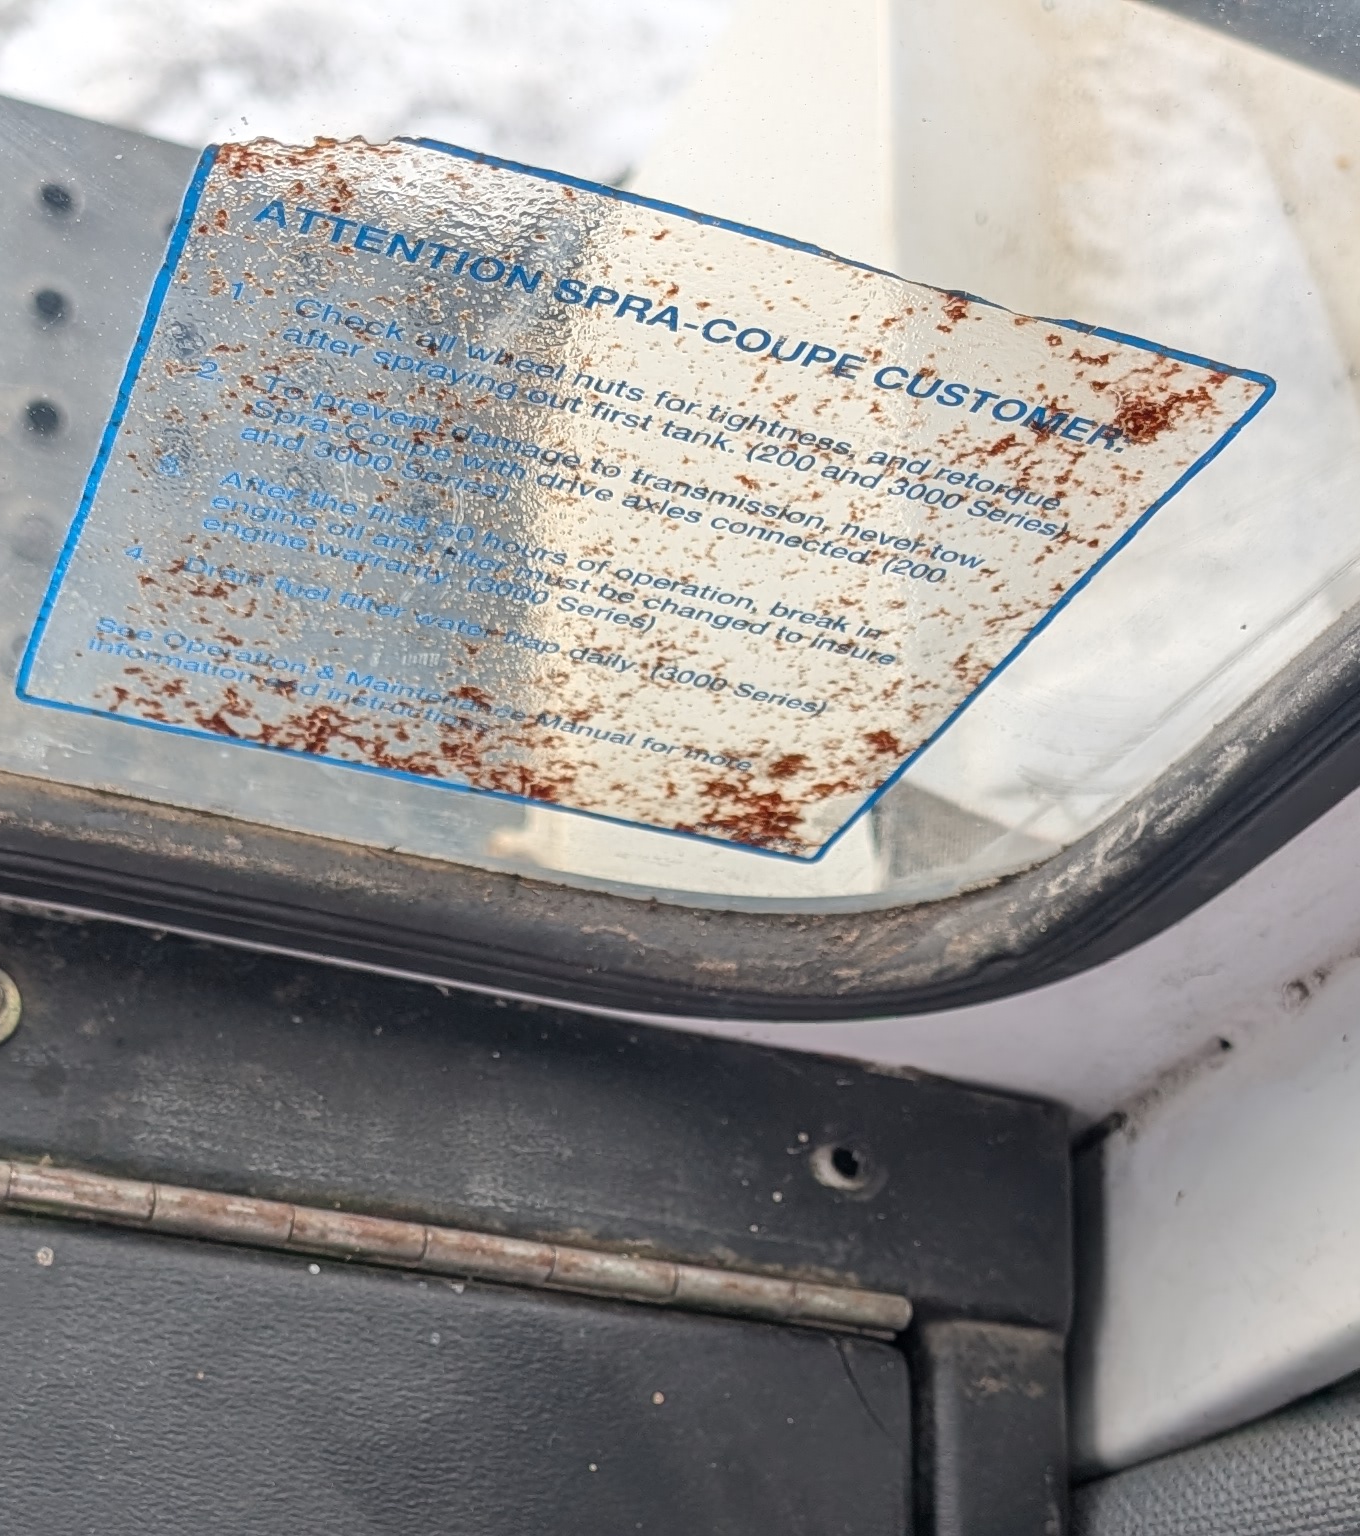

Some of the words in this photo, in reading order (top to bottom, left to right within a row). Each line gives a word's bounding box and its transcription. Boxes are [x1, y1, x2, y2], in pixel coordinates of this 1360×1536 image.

[252, 199, 545, 294] ATTENTION
[553, 278, 868, 380] SPRA-COUPE
[196, 360, 224, 382] 2.
[265, 374, 304, 400] To
[312, 392, 443, 435] prevent
[450, 424, 581, 470] damage
[590, 457, 622, 479] to
[629, 468, 829, 534] transmission,
[840, 522, 927, 553] never
[930, 544, 986, 571] tow
[231, 281, 255, 303] 1.
[295, 299, 405, 342] Check
[415, 332, 458, 354] all
[466, 343, 566, 382] wheel
[573, 371, 645, 403] nuts
[654, 390, 702, 415] for
[709, 404, 856, 461] tightness,
[868, 449, 932, 477] and
[933, 466, 1062, 512] retorque
[240, 425, 306, 452] and
[313, 440, 393, 474] 3000
[401, 460, 510, 501] Series)
[282, 327, 365, 359] after
[372, 350, 520, 402] spraying
[528, 387, 584, 414] out
[590, 400, 654, 432] first
[660, 418, 736, 453] tank.
[745, 441, 816, 473] (200
[820, 464, 883, 491] and
[887, 476, 964, 510] 3000
[966, 500, 1070, 542] Series)
[202, 516, 308, 550] engine
[468, 575, 549, 605] (3000
[556, 595, 657, 634] Series)
[218, 471, 302, 501] After
[309, 489, 358, 516] the
[367, 504, 430, 532] first
[481, 533, 568, 566] hours
[577, 557, 611, 575] of
[614, 568, 758, 615] operation,
[769, 601, 851, 633] break
[855, 620, 883, 640] in
[251, 400, 451, 462] Spra-Coupe
[462, 452, 527, 480] with
[536, 470, 614, 502] drive
[622, 495, 702, 525] axles
[881, 554, 947, 583] (200
[183, 556, 265, 588] Drain
[275, 575, 332, 600] fuel
[340, 590, 406, 619] filter
[569, 646, 639, 674] daily.
[650, 661, 728, 692] (3000
[733, 682, 828, 718] Series)
[211, 494, 319, 530] engine
[328, 522, 365, 541] oil
[372, 532, 432, 554] and
[514, 566, 592, 595] must
[598, 583, 636, 605] be
[642, 595, 771, 636] changed
[775, 625, 804, 644] to
[809, 631, 896, 666] insure
[96, 616, 153, 642] See
[163, 632, 307, 675] Operation
[316, 665, 335, 680] &
[538, 711, 636, 746] Manual
[641, 737, 680, 755] for
[684, 748, 752, 773] more
